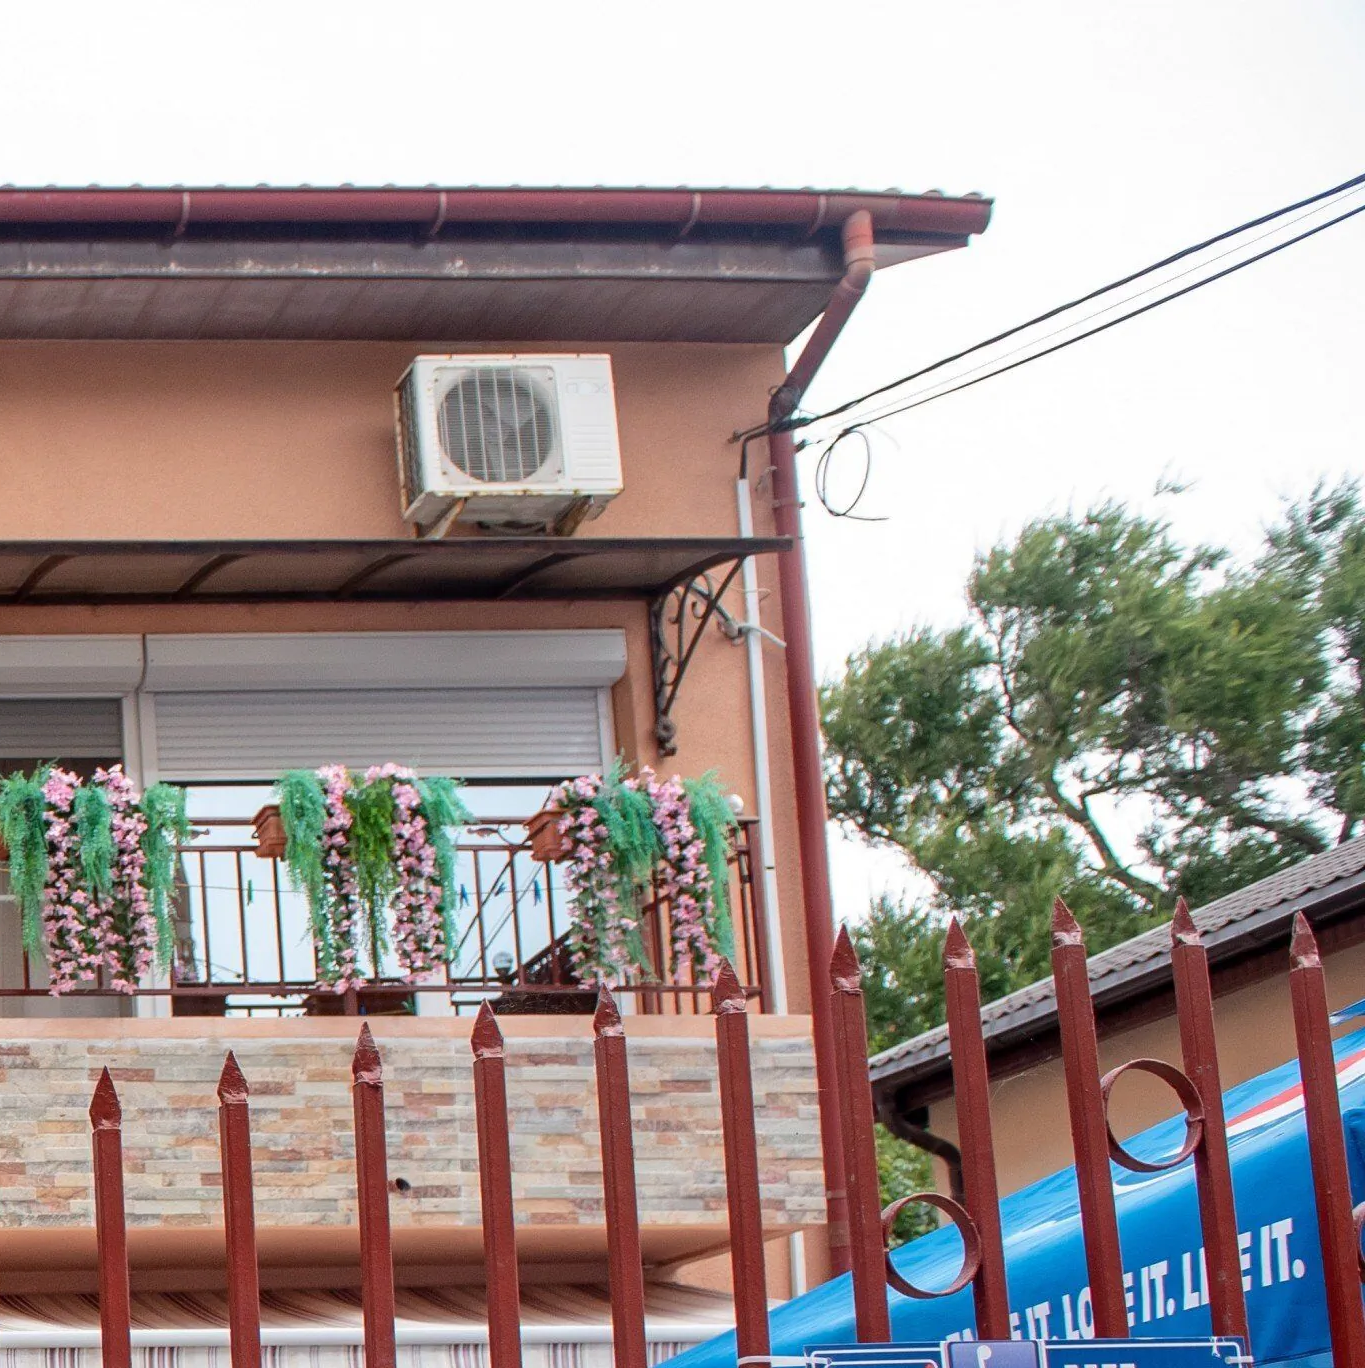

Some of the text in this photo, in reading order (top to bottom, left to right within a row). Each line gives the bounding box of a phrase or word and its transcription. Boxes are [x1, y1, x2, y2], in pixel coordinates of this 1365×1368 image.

[1062, 1272, 1135, 1340] LOE
[1141, 1260, 1176, 1324] IT.
[1181, 1231, 1253, 1312] LIE
[1260, 1217, 1306, 1288] IT.
